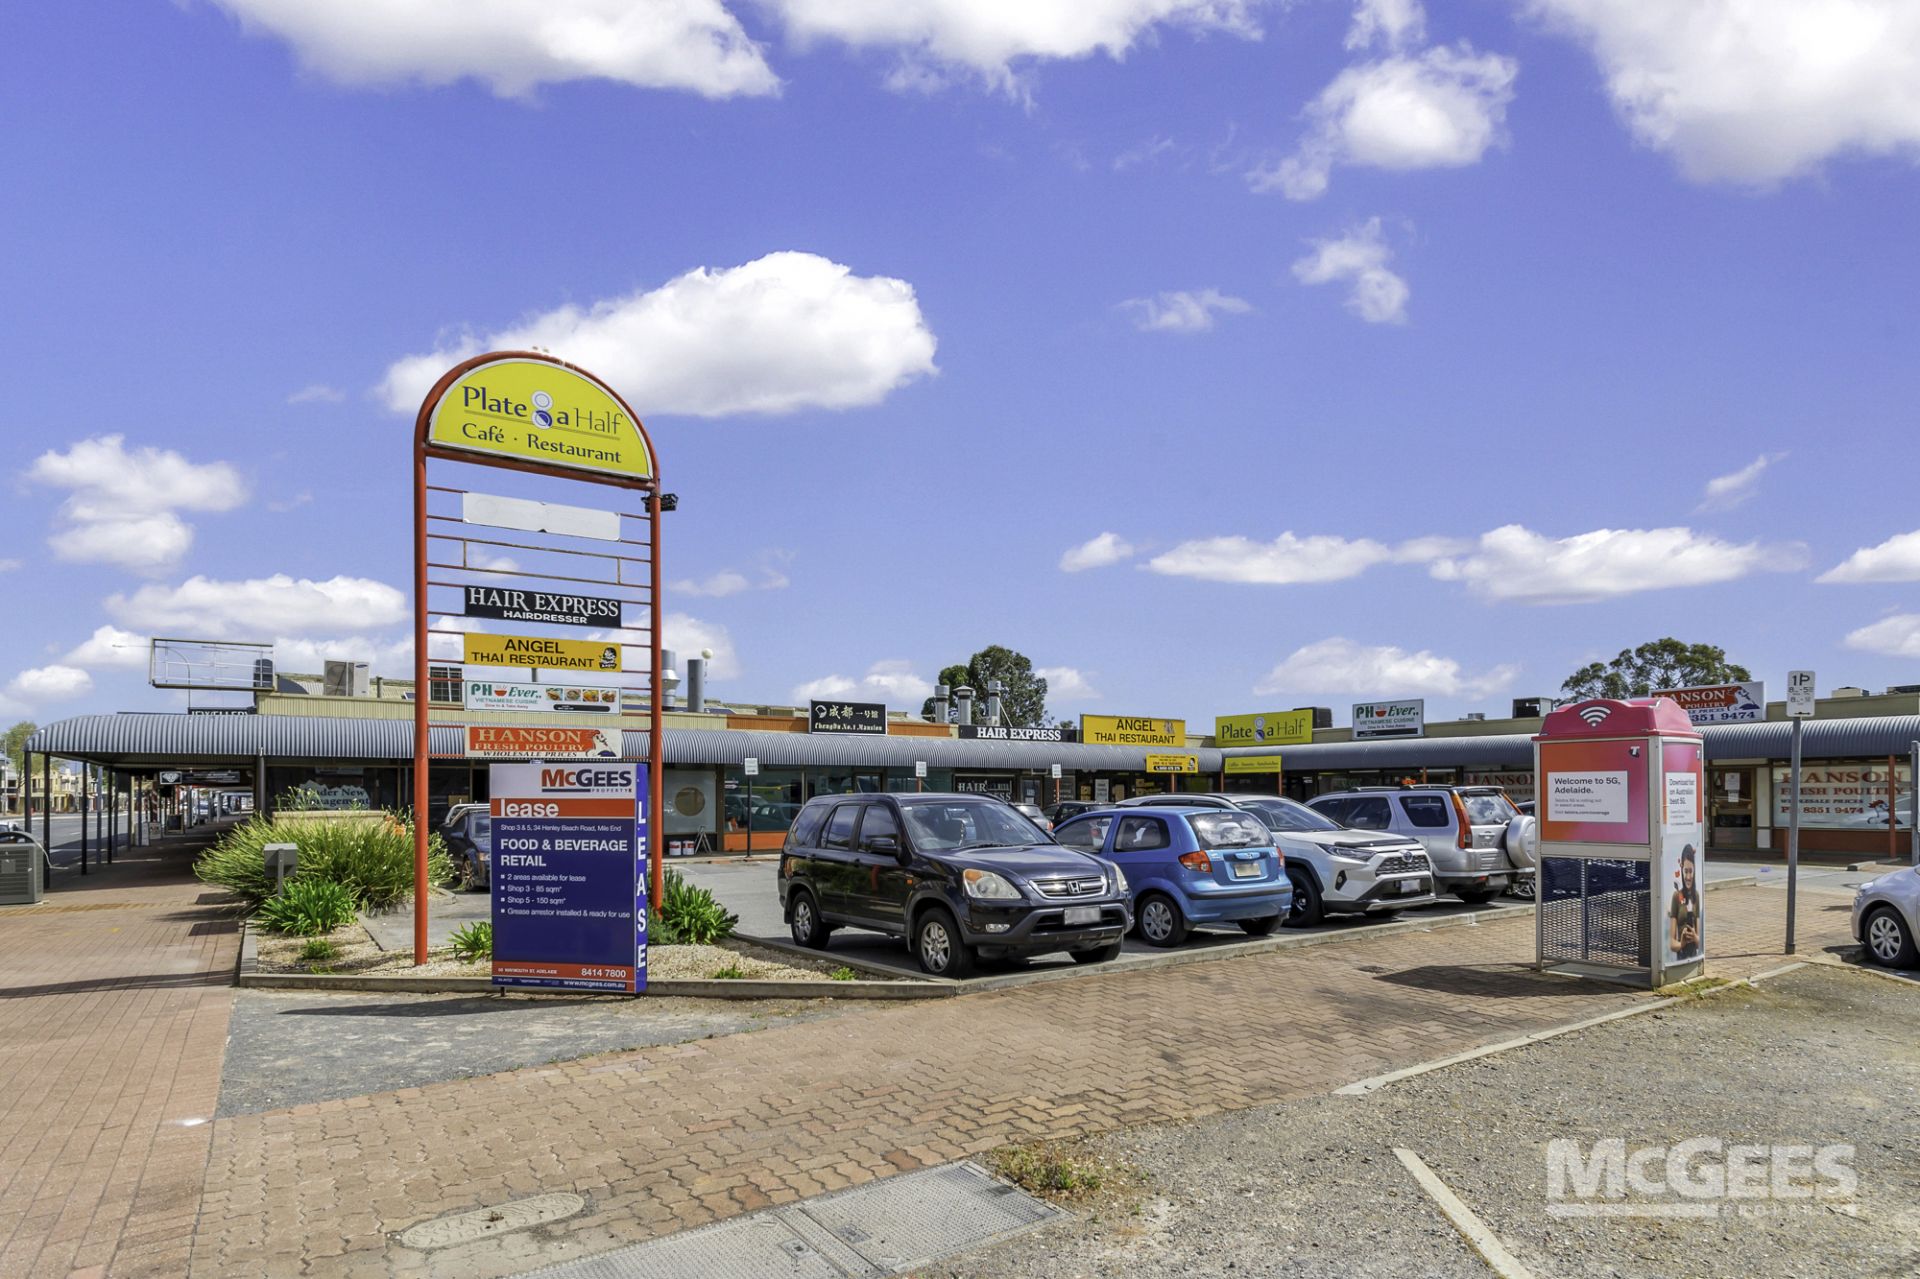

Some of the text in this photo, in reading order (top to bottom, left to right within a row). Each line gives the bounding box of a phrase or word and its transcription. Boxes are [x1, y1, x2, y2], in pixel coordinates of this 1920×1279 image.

[463, 386, 623, 434] Plate a Half
[462, 422, 621, 463] Café Restaurant
[469, 587, 619, 617] HAIR EXPRESS
[503, 610, 587, 624] HAIRDRESSER
[505, 639, 564, 654] ANGEL
[472, 652, 595, 667] THAI RESTAURANT
[1685, 701, 1726, 709] POULTRY
[1690, 712, 1755, 722] 351 9474
[1116, 719, 1156, 731] ANGEL
[1222, 718, 1305, 739] Plate a Half
[479, 729, 581, 743] HANSON
[977, 727, 1061, 741] HAIR EXPRESS
[1095, 732, 1175, 744] THAI RESTAURANT
[525, 743, 584, 751] POULTRY
[1468, 773, 1534, 785] HANSO
[342, 788, 364, 796] New
[958, 782, 987, 792] HAIR
[1781, 787, 1904, 795] FESH POULTY
[501, 799, 559, 818] lease
[501, 839, 628, 851] FOOD & BEVERAGE
[501, 855, 546, 866] RETAIL
[507, 896, 524, 904] Shop
[589, 910, 606, 918] ready
[581, 968, 626, 978] 8414 7800
[564, 980, 625, 988] www.mcgees.com.au
